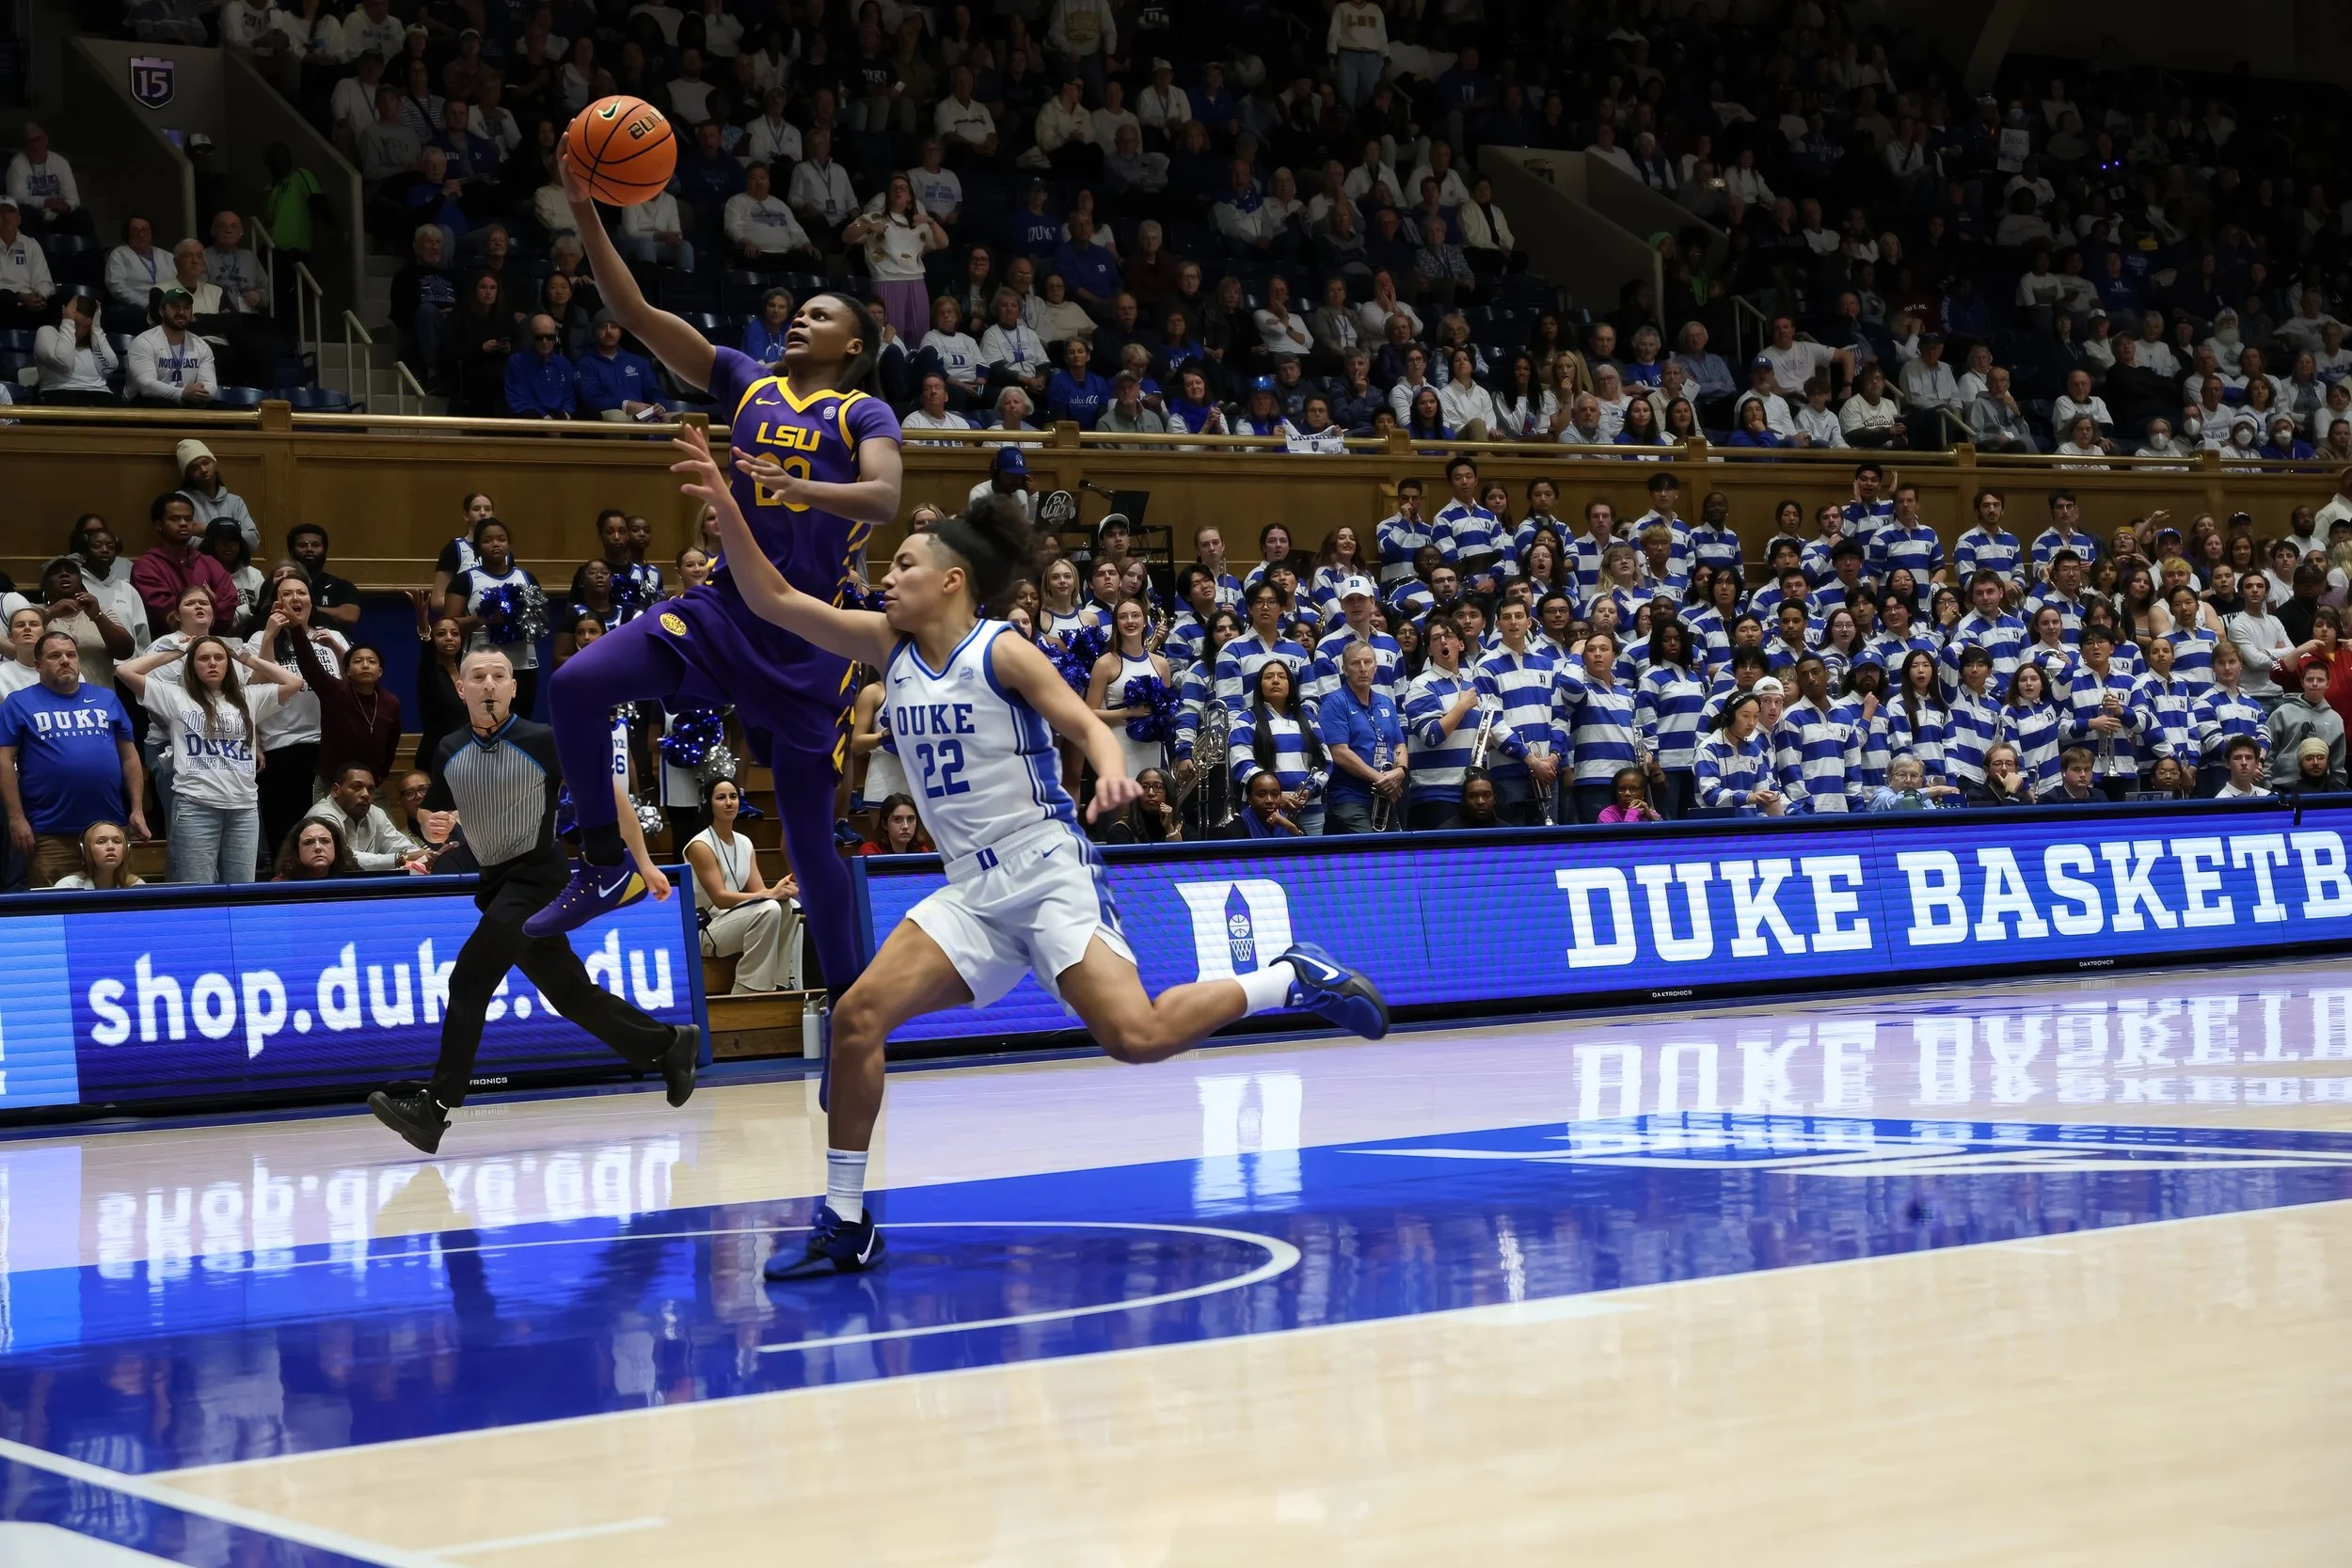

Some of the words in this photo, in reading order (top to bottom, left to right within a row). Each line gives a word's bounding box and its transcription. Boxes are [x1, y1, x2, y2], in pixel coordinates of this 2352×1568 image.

[136, 70, 168, 99] 15
[755, 421, 820, 452] LSU
[1387, 655, 1392, 663] D
[1539, 674, 1546, 684] D
[2118, 692, 2124, 701] D
[33, 708, 109, 733] DUKE
[897, 703, 976, 736] DUKE
[40, 730, 109, 741] BASKETBALL
[184, 733, 253, 761] DUKE
[915, 738, 971, 798] 22
[1554, 853, 1873, 969] DUKE
[1896, 829, 2352, 946] BASKETB
[1173, 878, 1295, 984] D
[1651, 989, 1693, 998] DAKTRONICS
[469, 1075, 509, 1087] TRONICS
